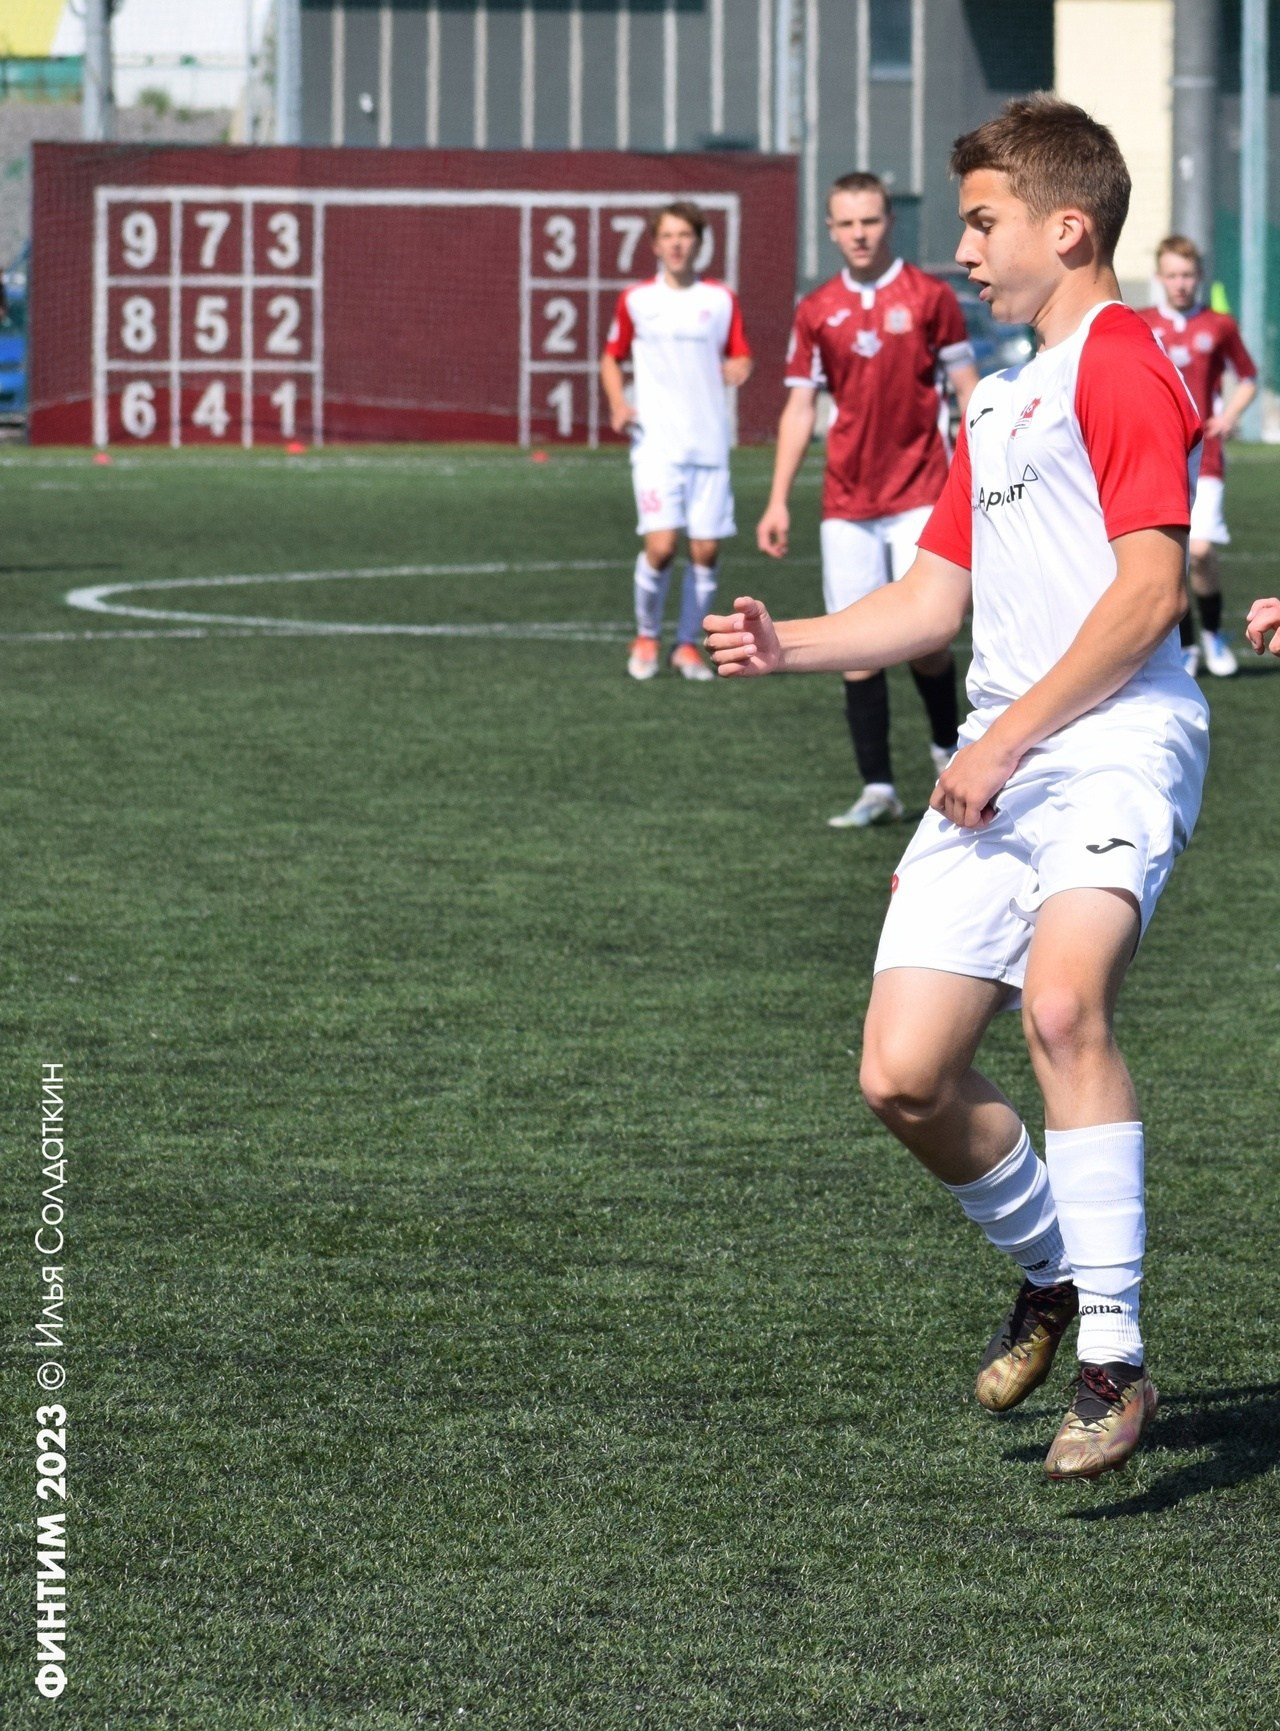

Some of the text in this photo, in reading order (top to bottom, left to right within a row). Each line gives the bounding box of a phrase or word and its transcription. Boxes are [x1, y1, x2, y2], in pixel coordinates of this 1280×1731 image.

[121, 211, 300, 269] 9 7 3
[545, 215, 577, 271] 3
[611, 216, 647, 272] 7
[121, 295, 301, 355] 8 5 2
[544, 298, 577, 354] 2
[121, 380, 297, 437] 6 4 1
[547, 381, 573, 436] 1
